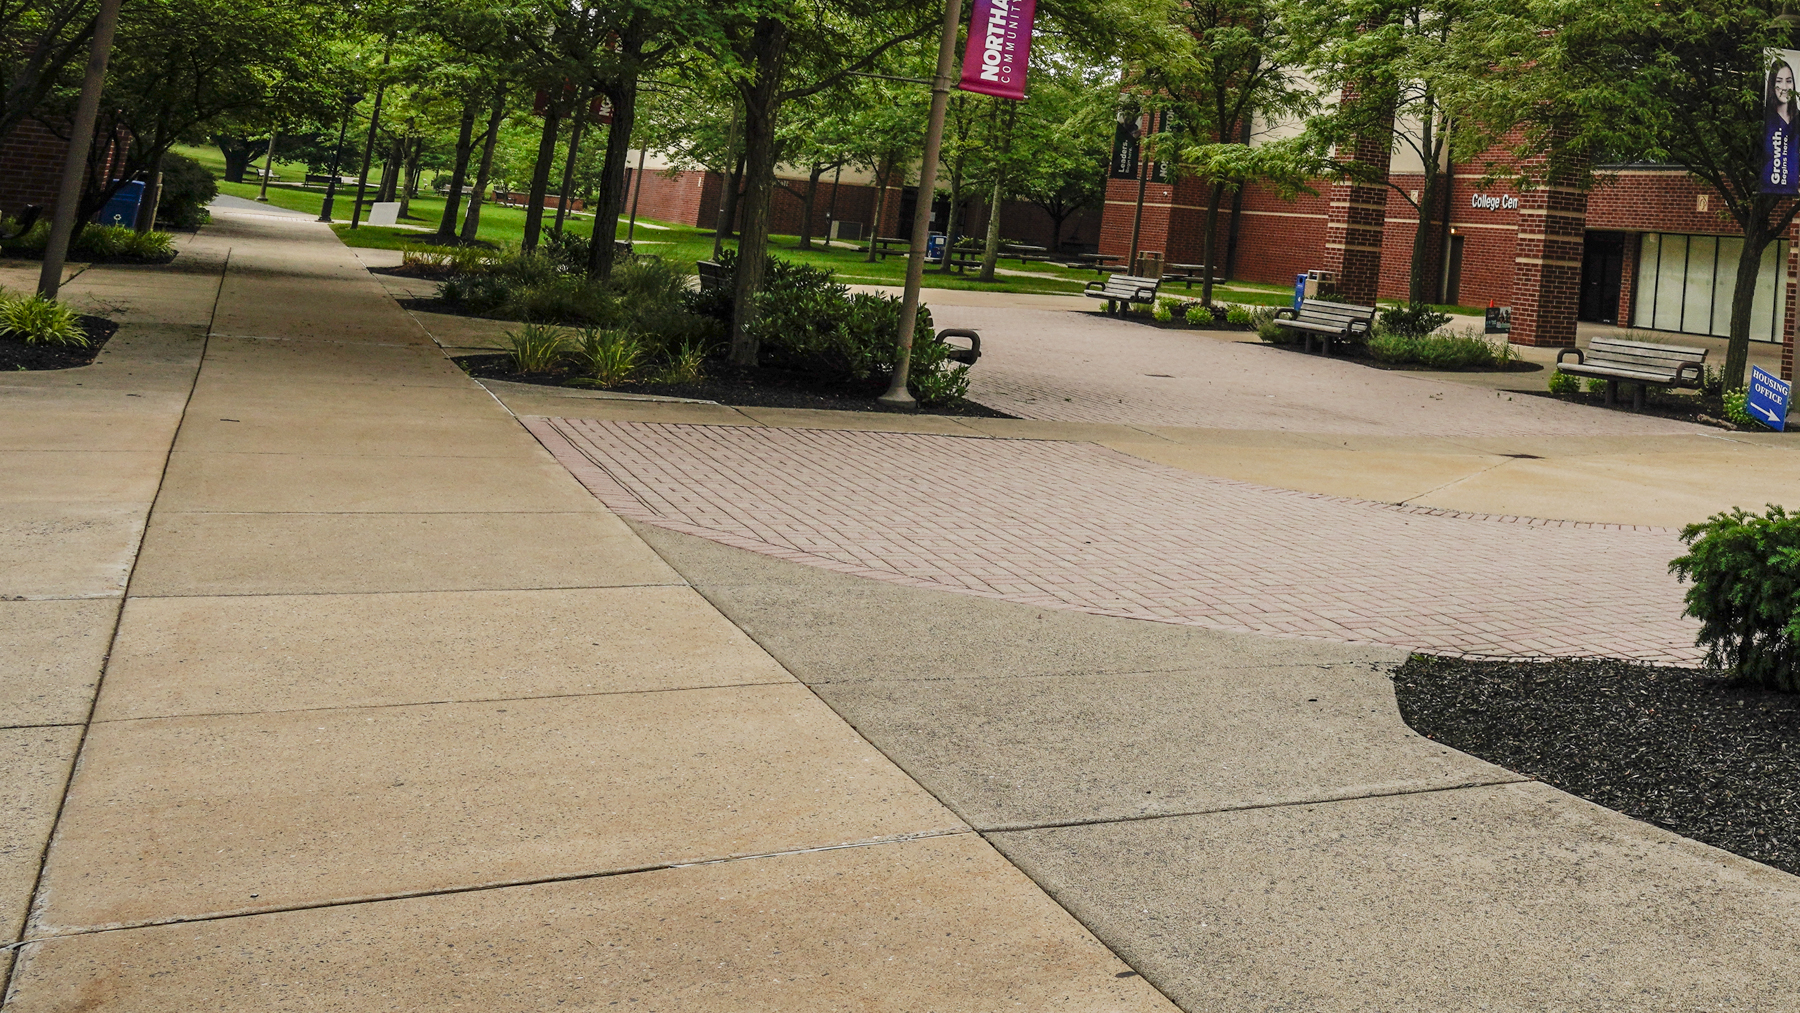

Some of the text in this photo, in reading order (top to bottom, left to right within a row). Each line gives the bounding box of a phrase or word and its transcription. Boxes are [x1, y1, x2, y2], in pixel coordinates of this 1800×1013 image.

[1771, 127, 1782, 185] Growth.
[1472, 193, 1500, 211] College
[1753, 369, 1789, 396] HOUSING
[1755, 383, 1783, 405] OFFICE
